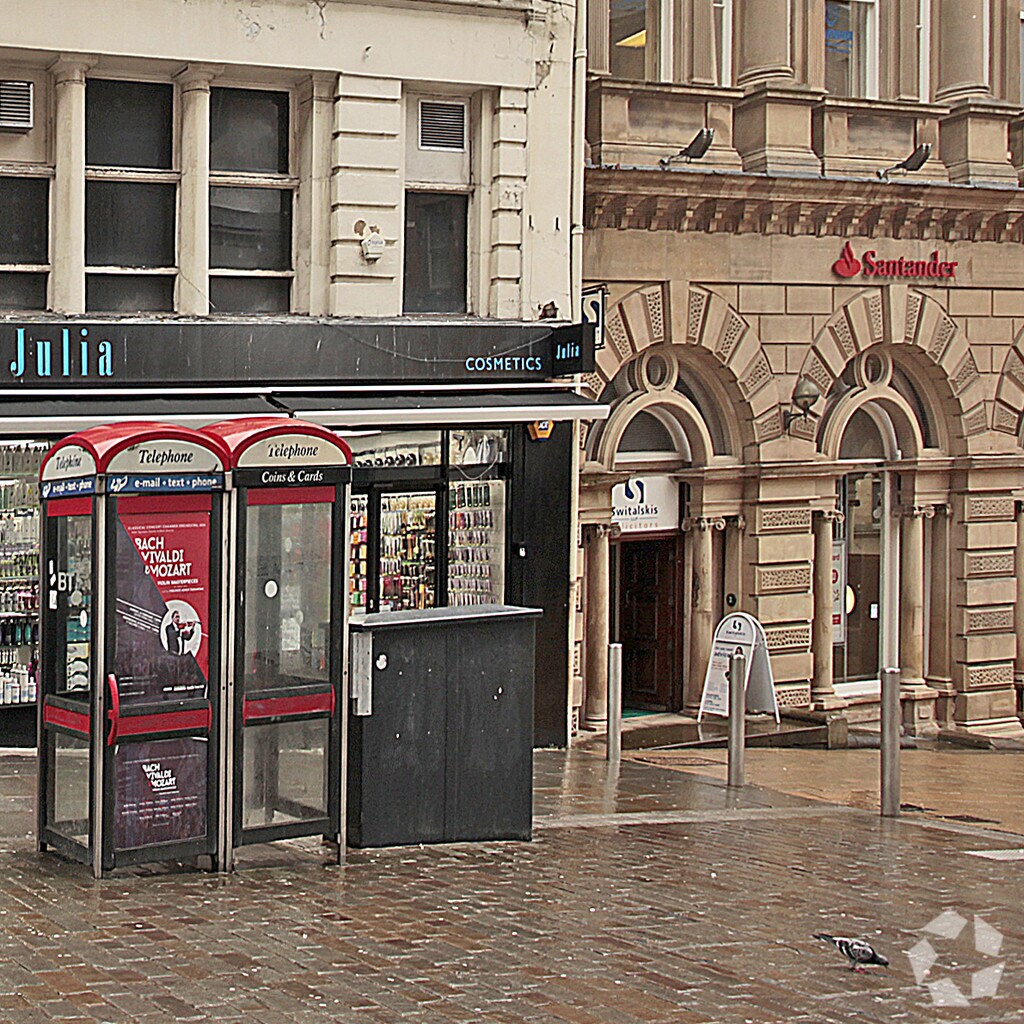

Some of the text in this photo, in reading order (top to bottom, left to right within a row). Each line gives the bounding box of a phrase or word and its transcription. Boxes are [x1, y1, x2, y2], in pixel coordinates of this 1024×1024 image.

[862, 249, 959, 279] Santander
[10, 327, 114, 377] Julia
[556, 342, 580, 361] Julia
[465, 357, 543, 372] COSMETICS
[138, 449, 194, 467] Telephone
[267, 443, 319, 460] Telephone
[134, 477, 160, 488] e-mail
[167, 478, 185, 488] text
[192, 476, 218, 489] phone
[261, 470, 324, 484] Coins & Cards
[612, 504, 659, 517] Switalskis
[621, 522, 659, 530] licitors
[141, 549, 184, 564] VIVALDI
